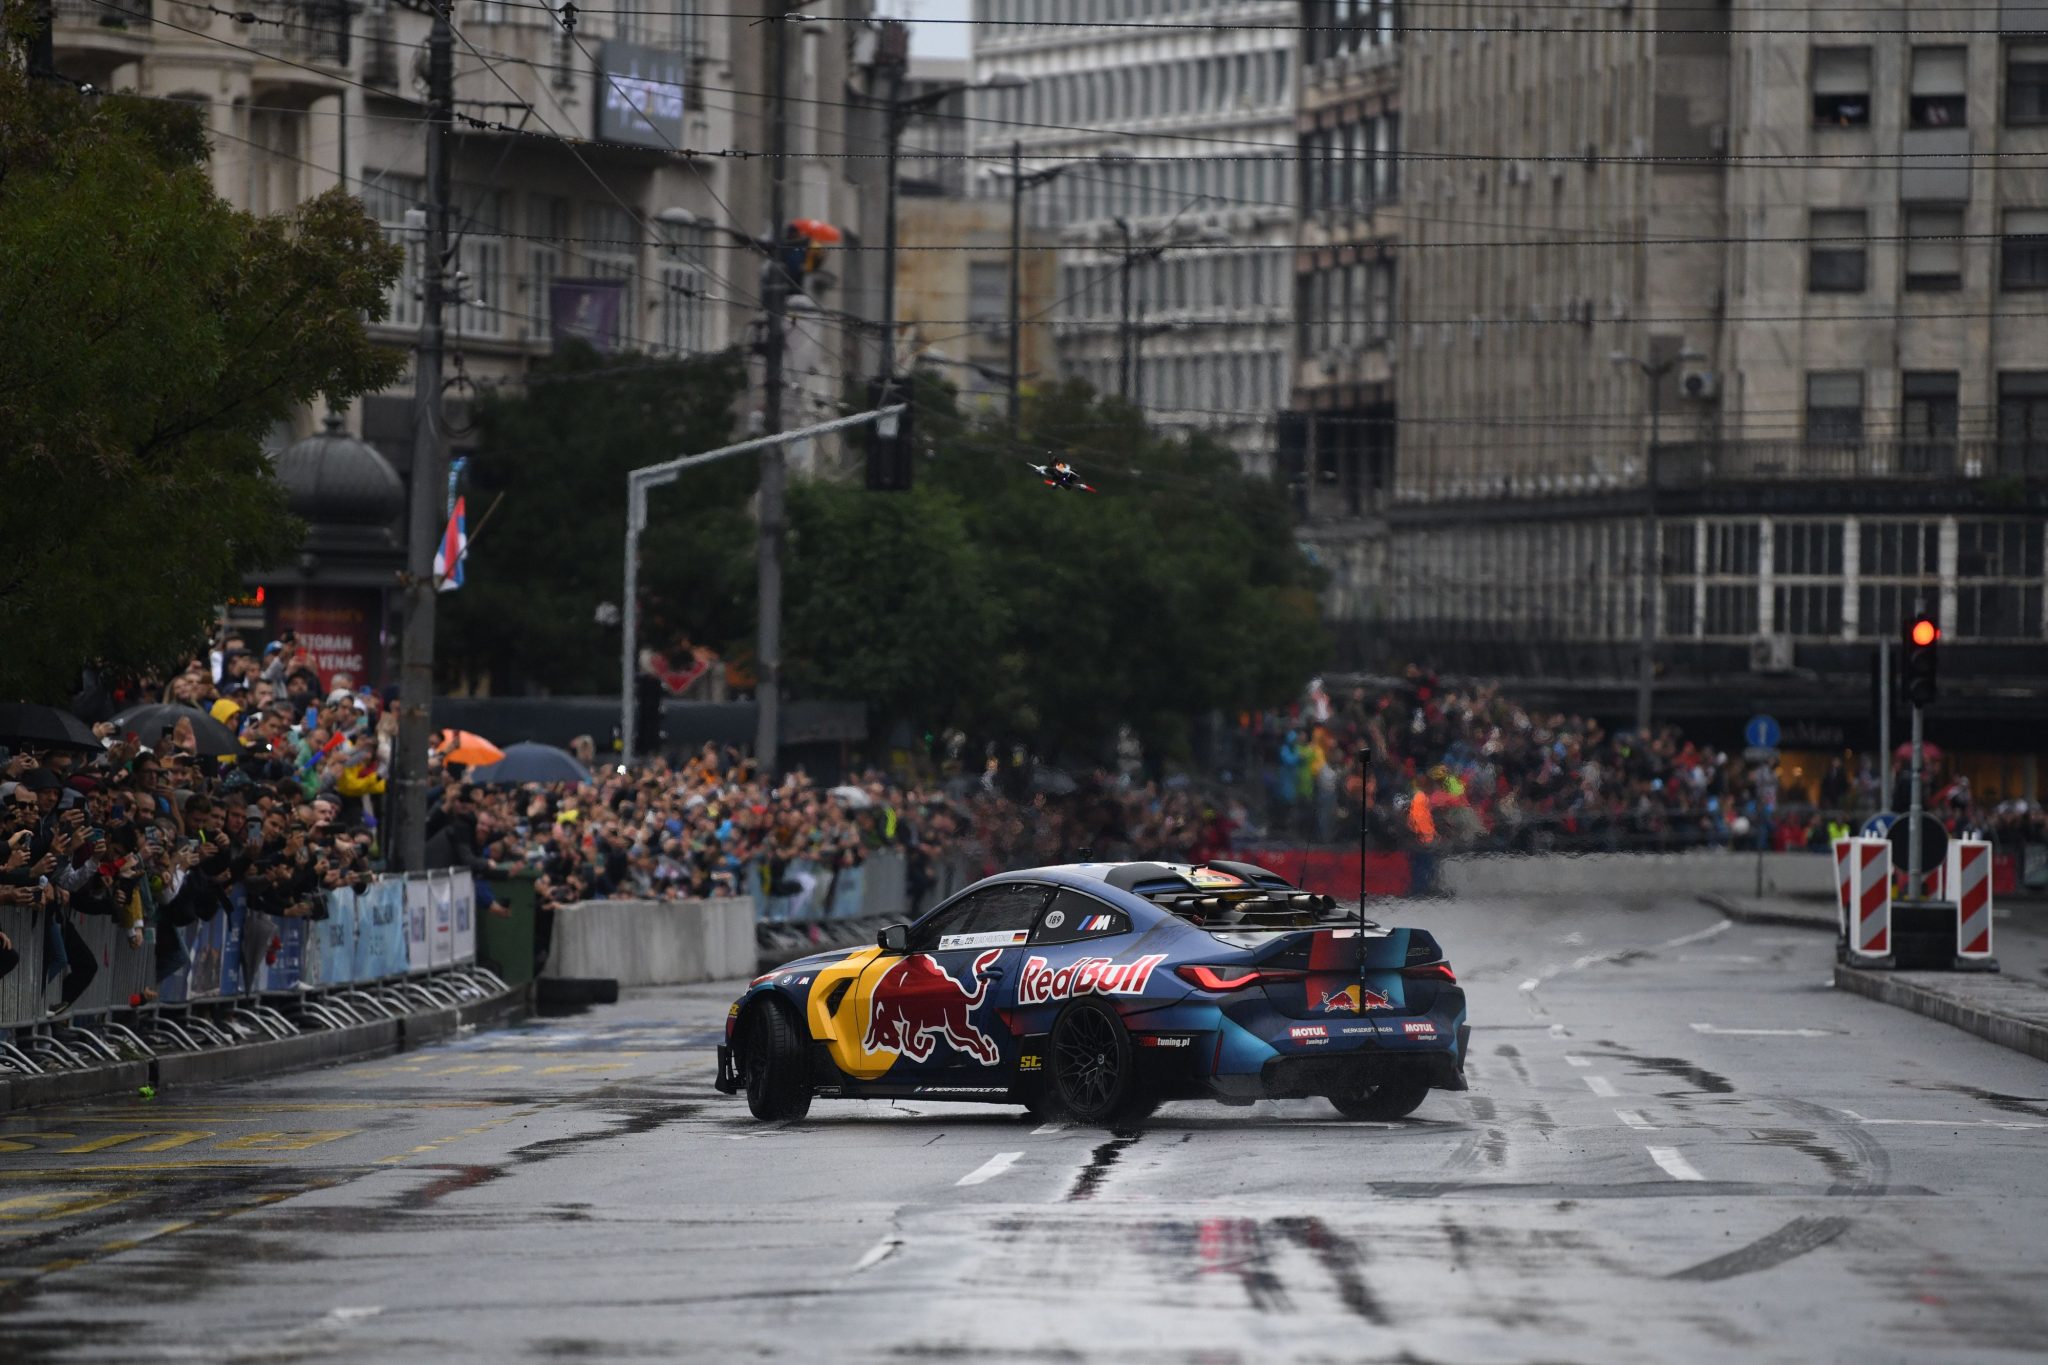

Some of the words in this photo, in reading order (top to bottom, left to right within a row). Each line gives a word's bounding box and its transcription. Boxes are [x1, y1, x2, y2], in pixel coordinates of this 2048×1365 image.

[964, 936, 975, 945] 229
[1018, 955, 1092, 1005] Red
[1072, 953, 1169, 997] Bull
[1291, 1026, 1326, 1038] MOTUL
[1404, 1023, 1435, 1033] MOTUL
[1157, 1037, 1191, 1048] tuning.pl
